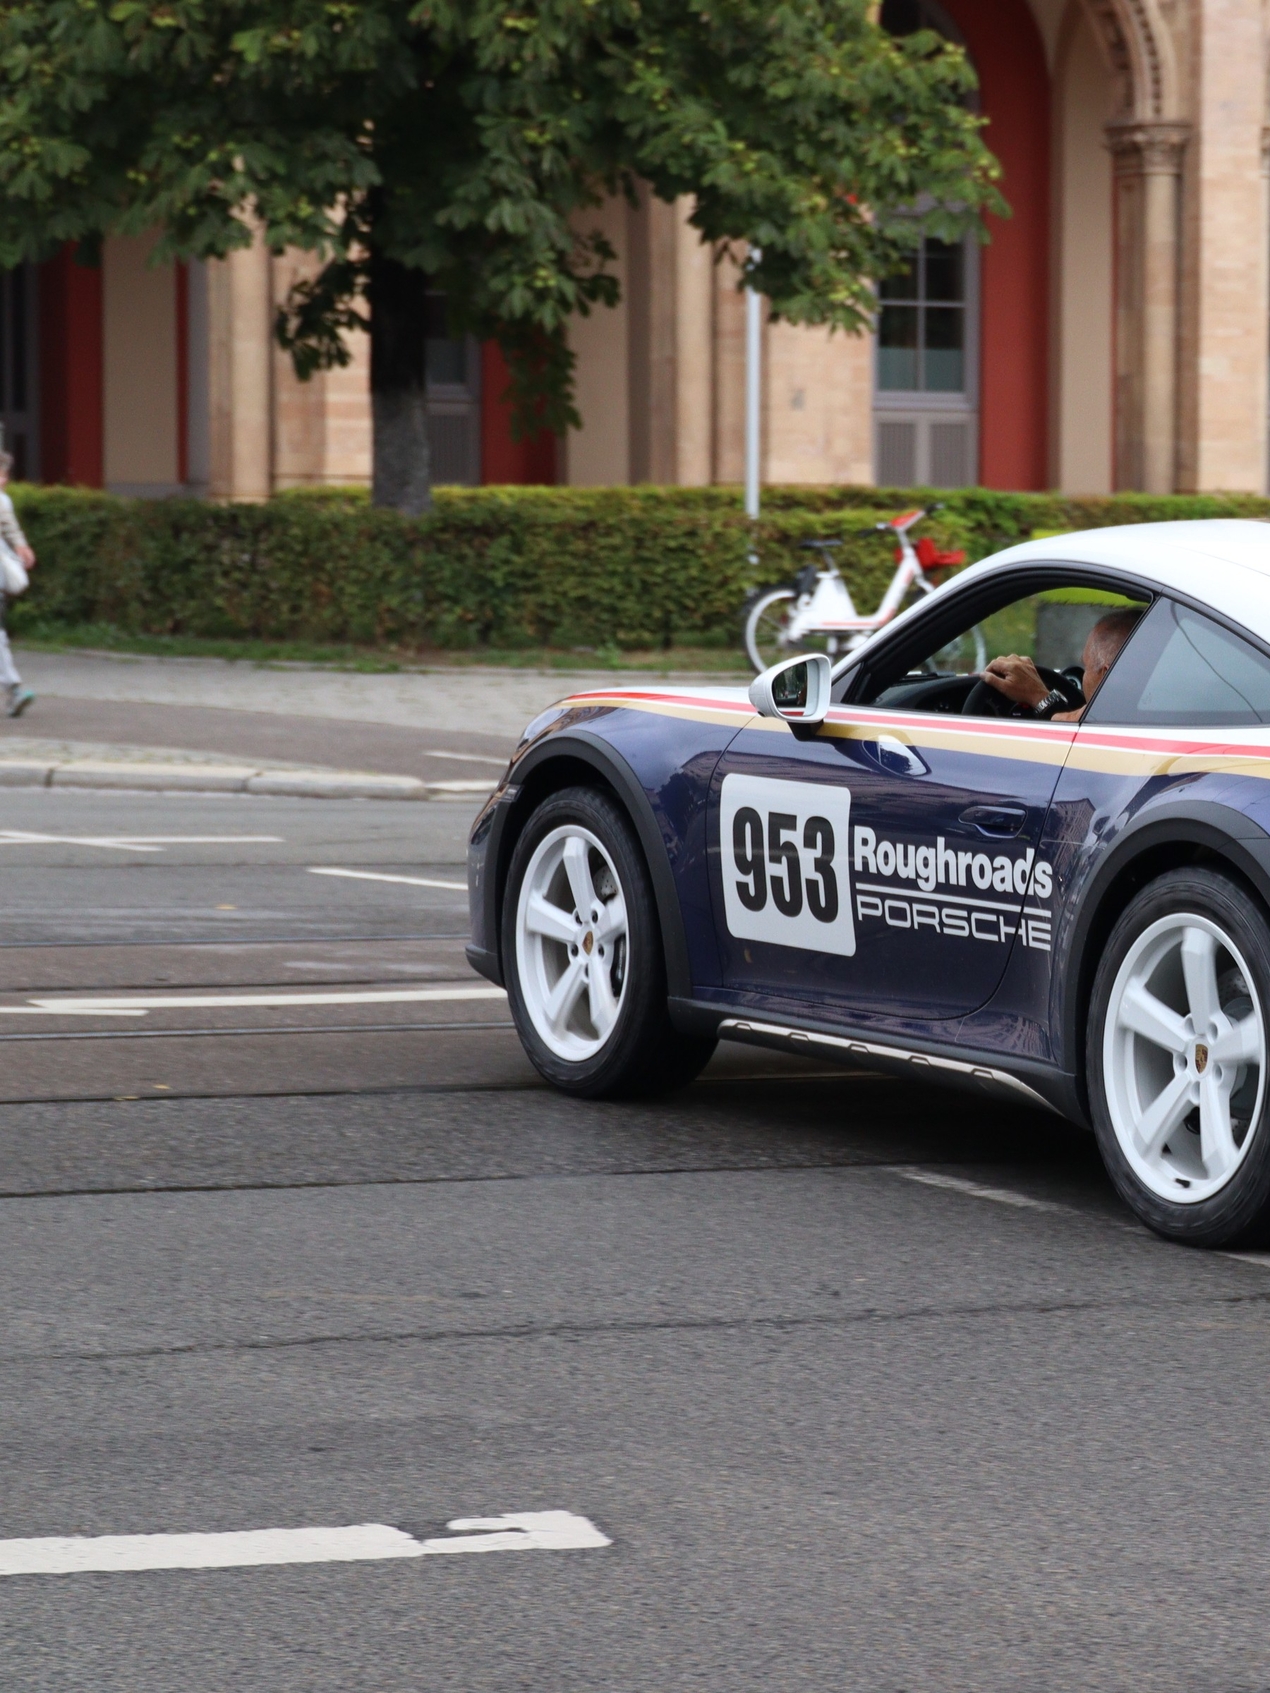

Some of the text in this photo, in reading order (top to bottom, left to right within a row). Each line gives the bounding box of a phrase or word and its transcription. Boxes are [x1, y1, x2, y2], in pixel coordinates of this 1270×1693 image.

[732, 806, 840, 924] 953
[853, 824, 1054, 899] Roughroads
[855, 894, 1052, 952] PORSCHE
